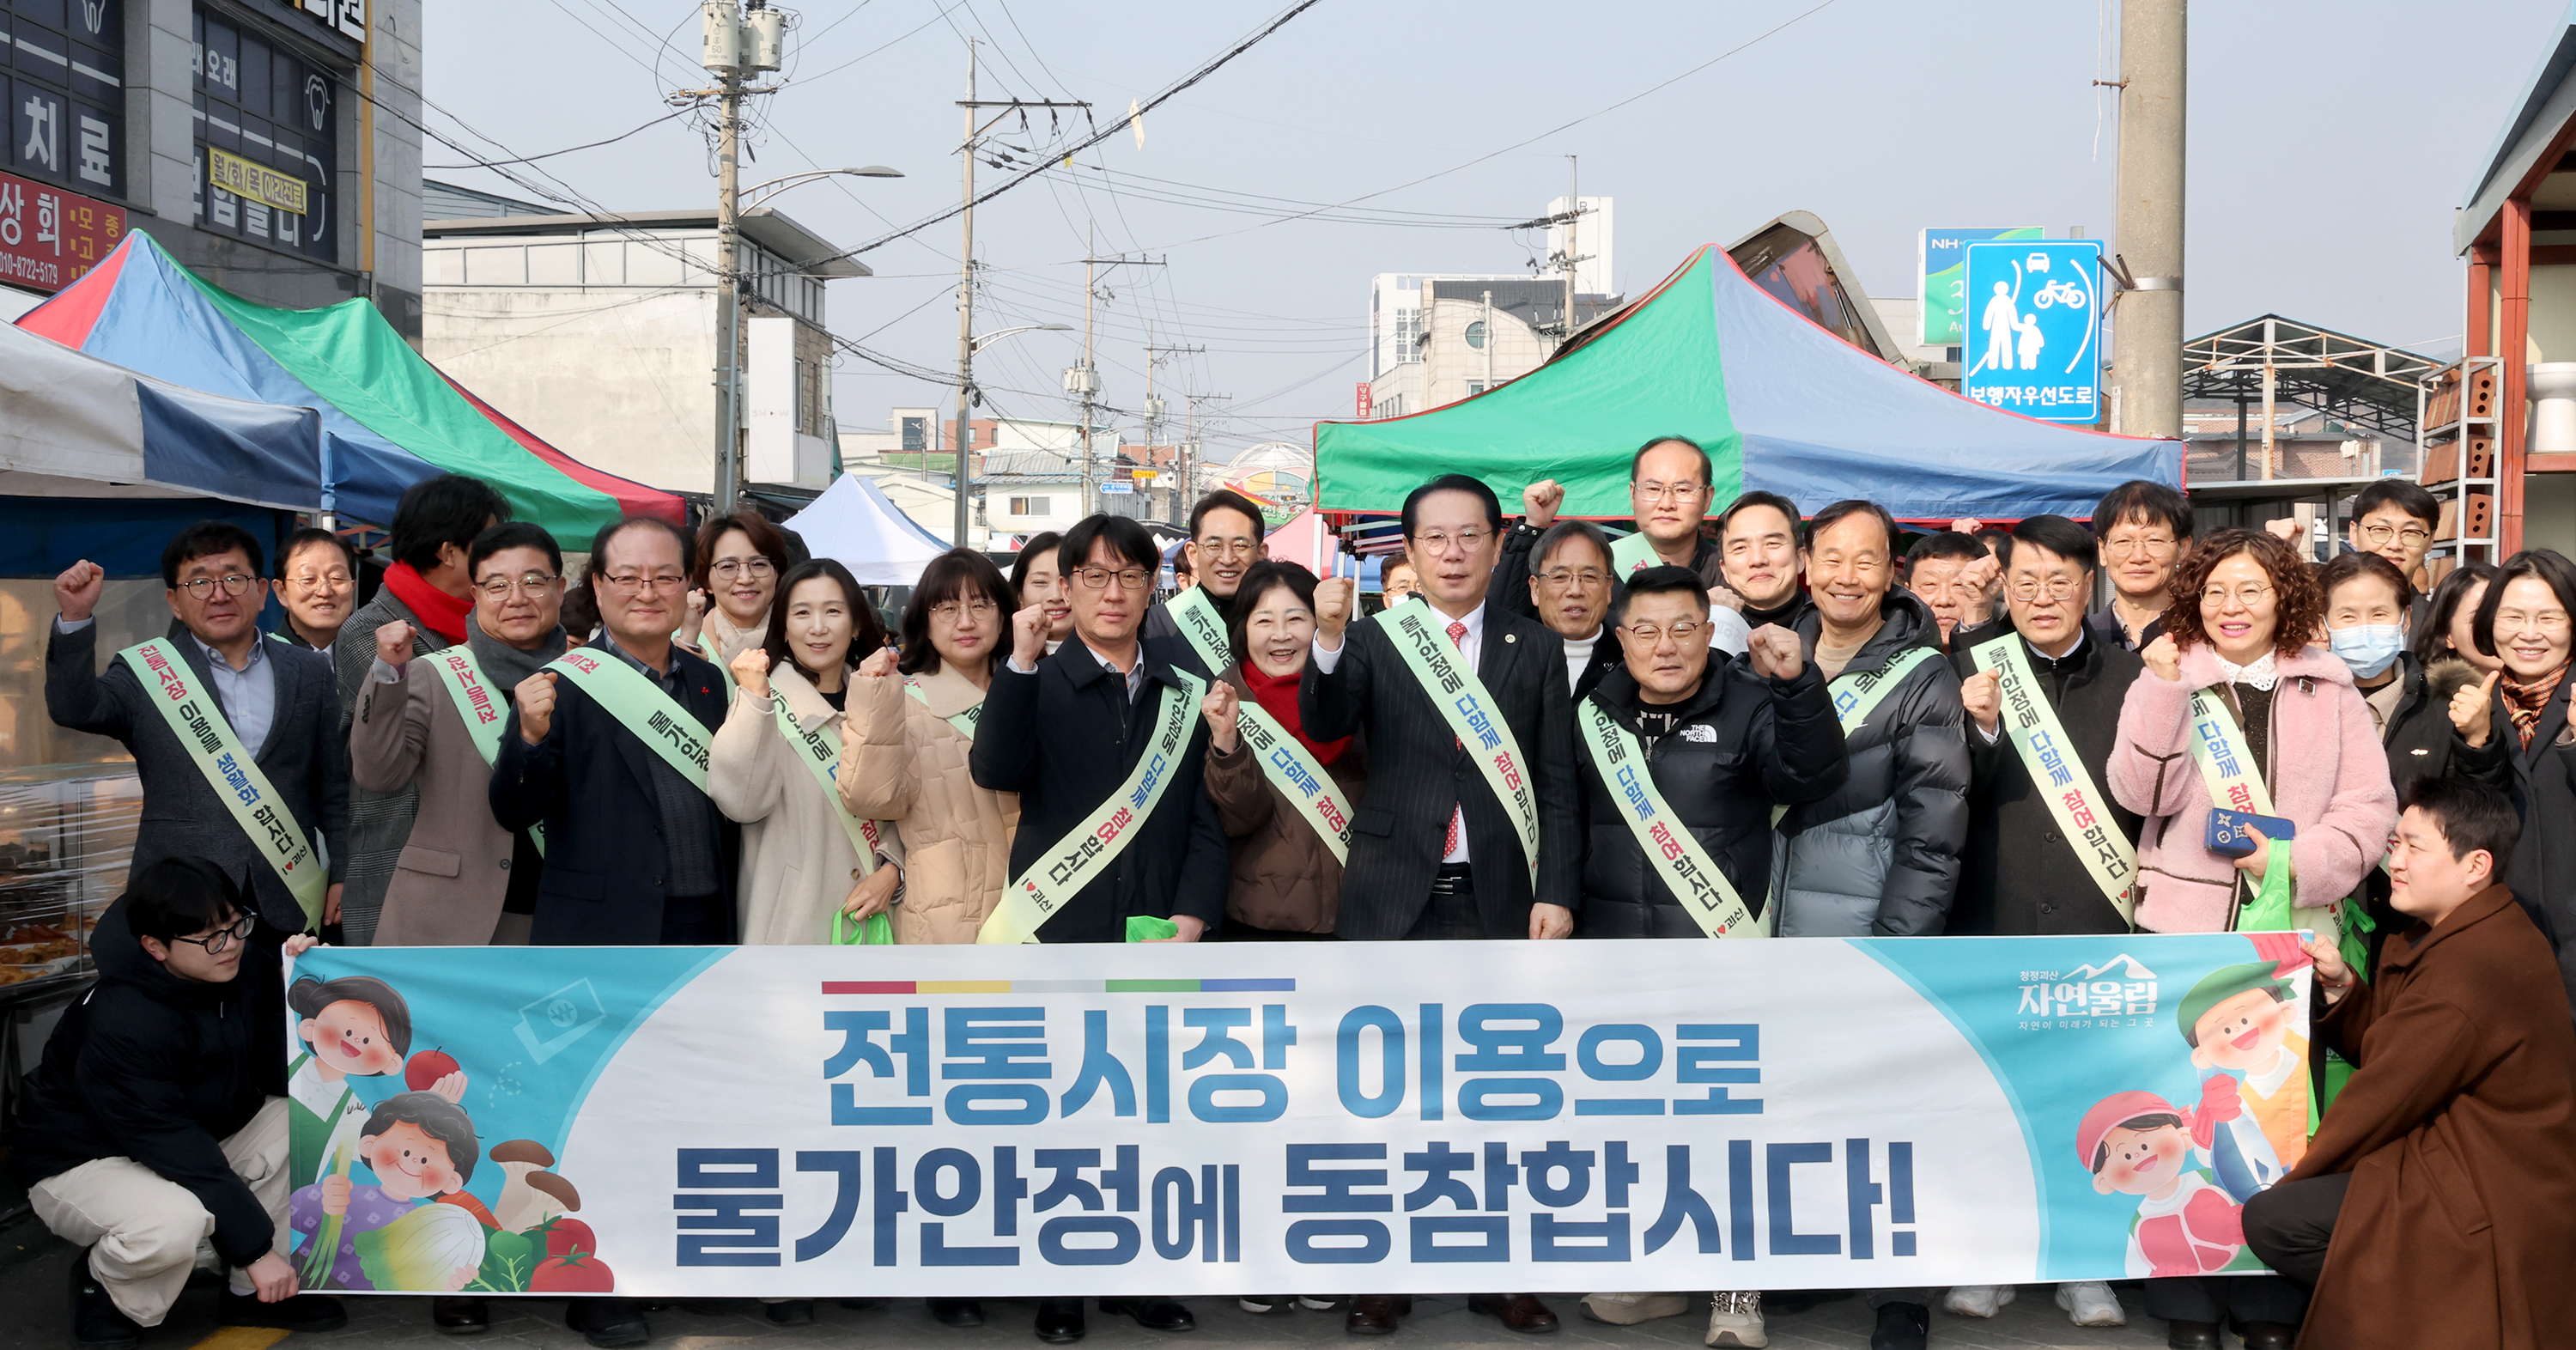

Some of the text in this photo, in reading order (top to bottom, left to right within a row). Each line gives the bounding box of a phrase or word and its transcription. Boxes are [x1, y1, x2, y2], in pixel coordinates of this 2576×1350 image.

[25, 95, 112, 187] 치료
[1971, 386, 2093, 406] 보행자우선도로
[446, 655, 498, 725] 전통시장
[1399, 614, 1465, 695] 물가안정에
[1455, 693, 1502, 751] 다함께
[1988, 646, 2041, 730] 물가안정에
[2028, 730, 2073, 788] 다함께
[137, 646, 294, 855] 전통시장 이용을 생활화 합시다
[1130, 752, 1166, 811] 다함께
[1270, 746, 1321, 799] 다함께
[2198, 720, 2241, 781] 다함께
[1616, 764, 1656, 821] 다함께
[1048, 806, 1133, 887] 참여합시다
[2017, 981, 2158, 1017] 자연울림
[2020, 970, 2059, 982] 청정괴산
[2019, 1017, 2154, 1031] 자연이 미래가 되는 그 곳
[823, 1002, 1765, 1126] 전통시장 이용으로
[673, 1138, 1917, 1267] 물가안정에 동참합시다!
